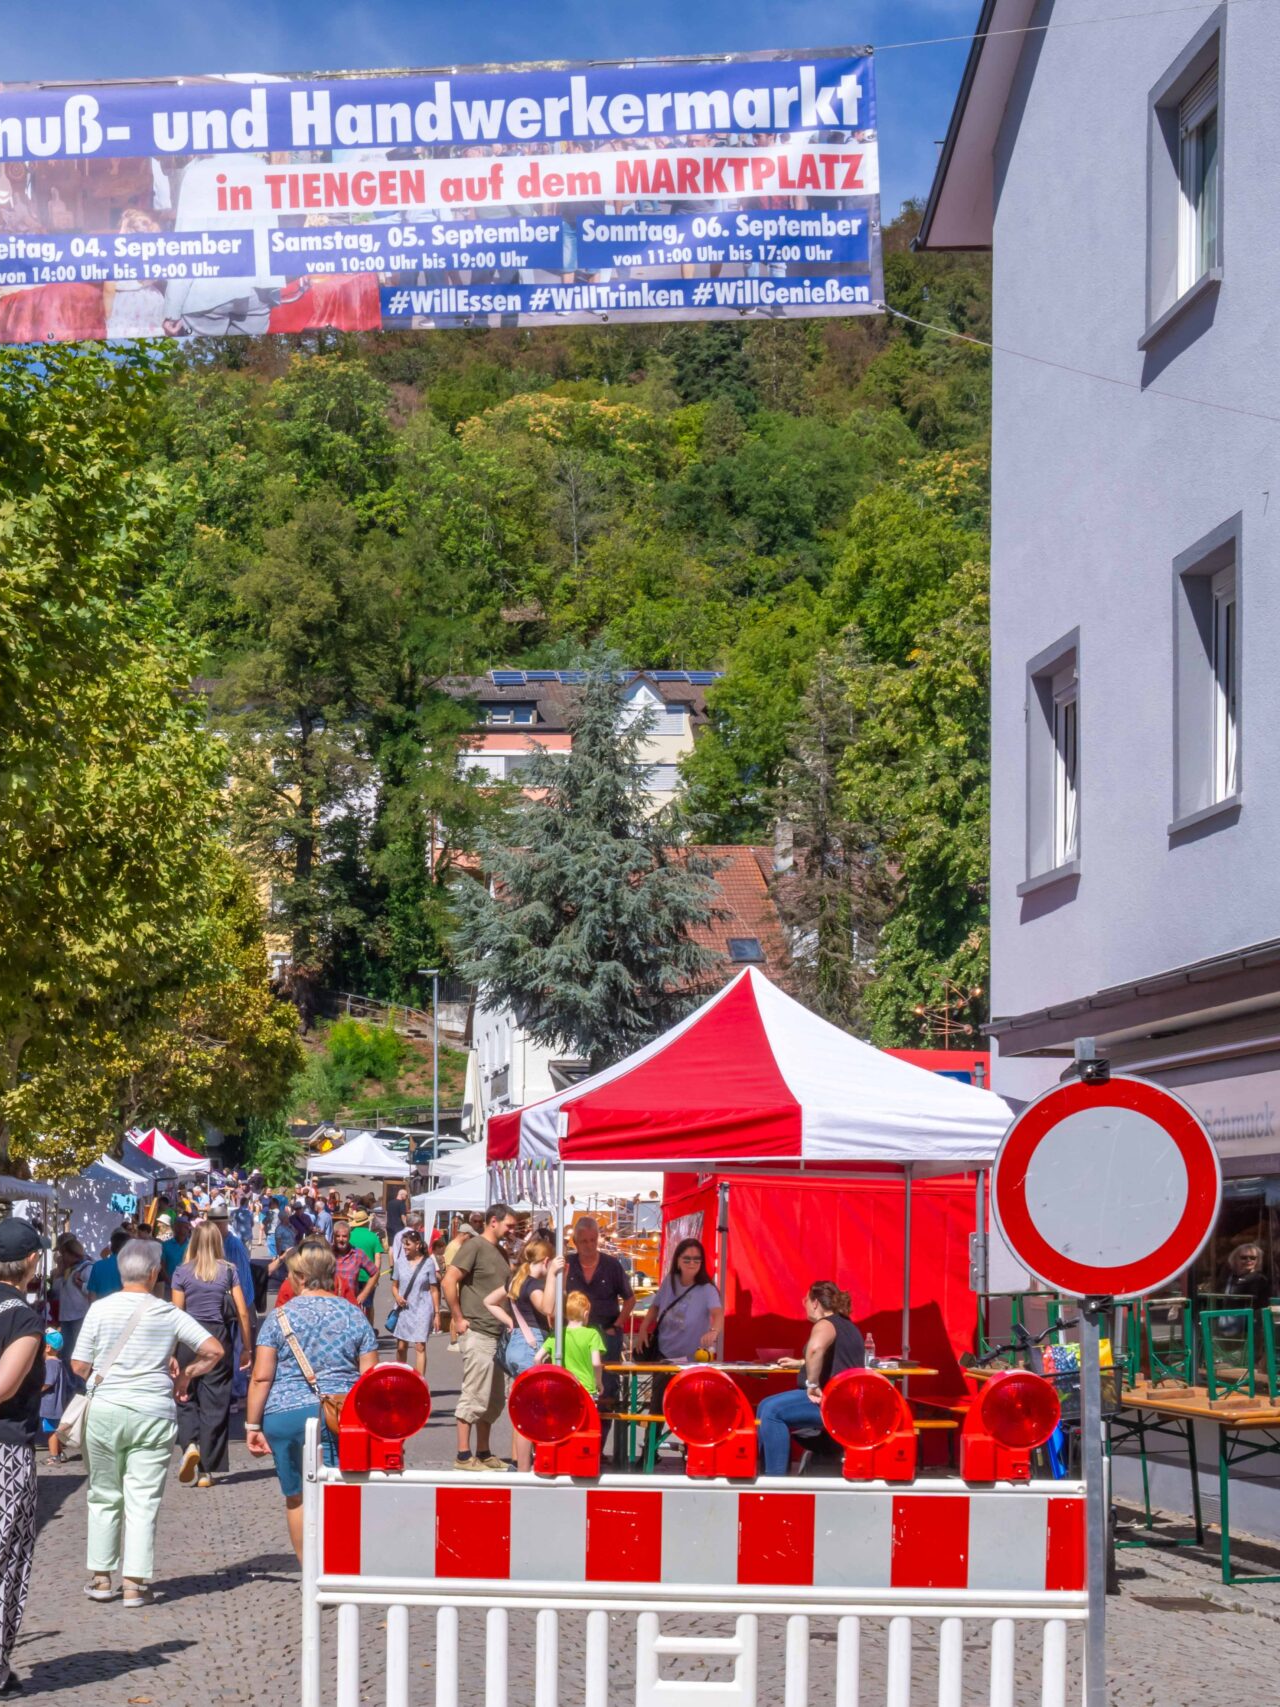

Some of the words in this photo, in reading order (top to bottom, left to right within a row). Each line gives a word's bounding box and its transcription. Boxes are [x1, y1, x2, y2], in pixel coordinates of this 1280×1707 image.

[152, 88, 268, 152] und
[291, 66, 863, 146] Handwerkermarkt
[216, 174, 253, 211] in
[265, 169, 427, 209] TIENGEN
[439, 163, 504, 202] auf
[517, 161, 602, 198] dem
[615, 153, 865, 195] MARKTPLATZ
[271, 231, 381, 254] Samstag,
[387, 226, 425, 248] 05.
[431, 219, 559, 249] September
[582, 217, 686, 245] Sonntag,
[692, 216, 729, 239] 06.
[736, 211, 862, 241] September
[70, 238, 108, 259] 04.
[113, 233, 242, 261] September
[306, 259, 335, 274] von
[340, 256, 385, 273] 10:00
[389, 254, 418, 271] Uhr
[422, 252, 447, 269] bis
[451, 251, 496, 268] 19:00
[500, 250, 528, 267] Uhr
[613, 253, 643, 267] von
[647, 250, 693, 265] 11:00
[697, 246, 726, 262] Uhr
[729, 245, 754, 261] bis
[758, 246, 801, 262] 17:00
[803, 243, 833, 261] Uhr
[32, 265, 76, 284] 14:00
[81, 263, 109, 281] Uhr
[114, 263, 137, 280] bis
[143, 262, 187, 279] 19:00
[191, 261, 220, 277] Uhr
[388, 287, 521, 314] #WillEssen
[529, 282, 684, 312] #WillTrinken
[692, 280, 870, 305] #WillGenießen
